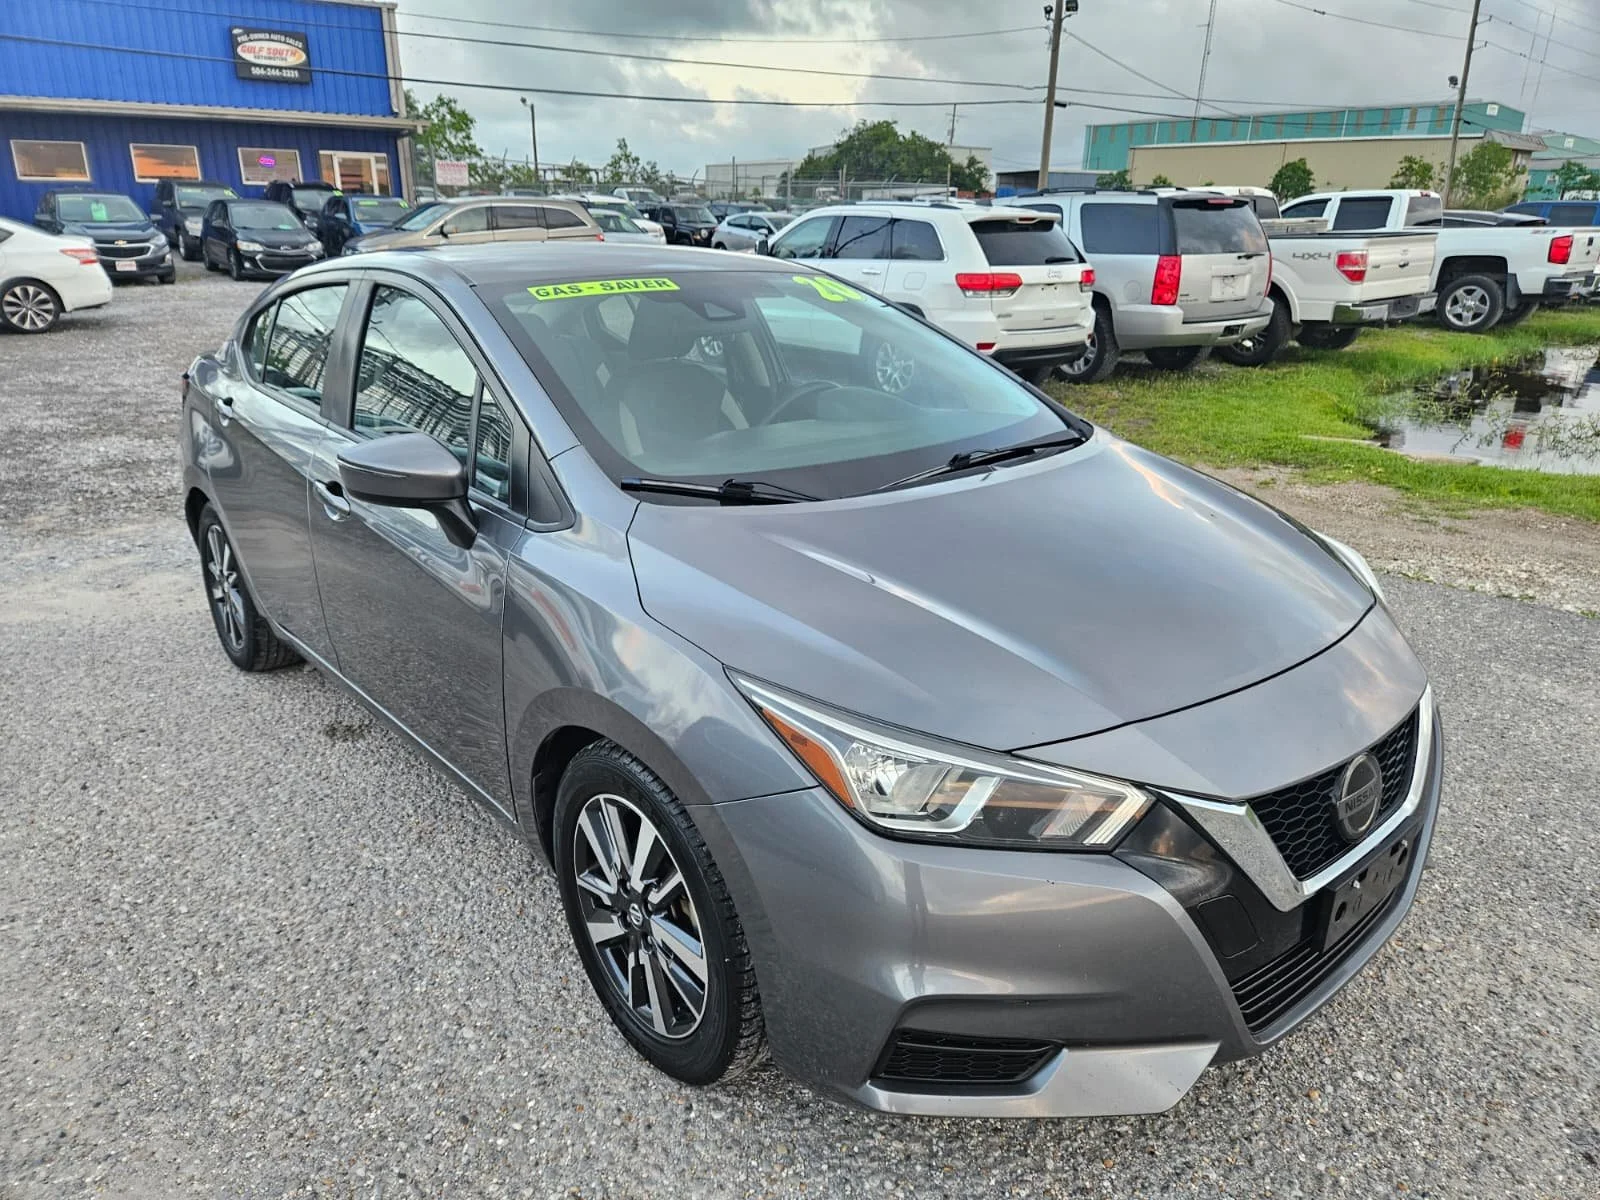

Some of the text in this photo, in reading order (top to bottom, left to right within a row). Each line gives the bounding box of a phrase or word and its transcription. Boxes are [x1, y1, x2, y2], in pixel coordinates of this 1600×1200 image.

[270, 33, 285, 42] AUTO
[286, 37, 303, 48] SALES
[240, 45, 296, 57] GULF SOUTH
[535, 284, 582, 297] GAS
[600, 279, 671, 291] SAVER
